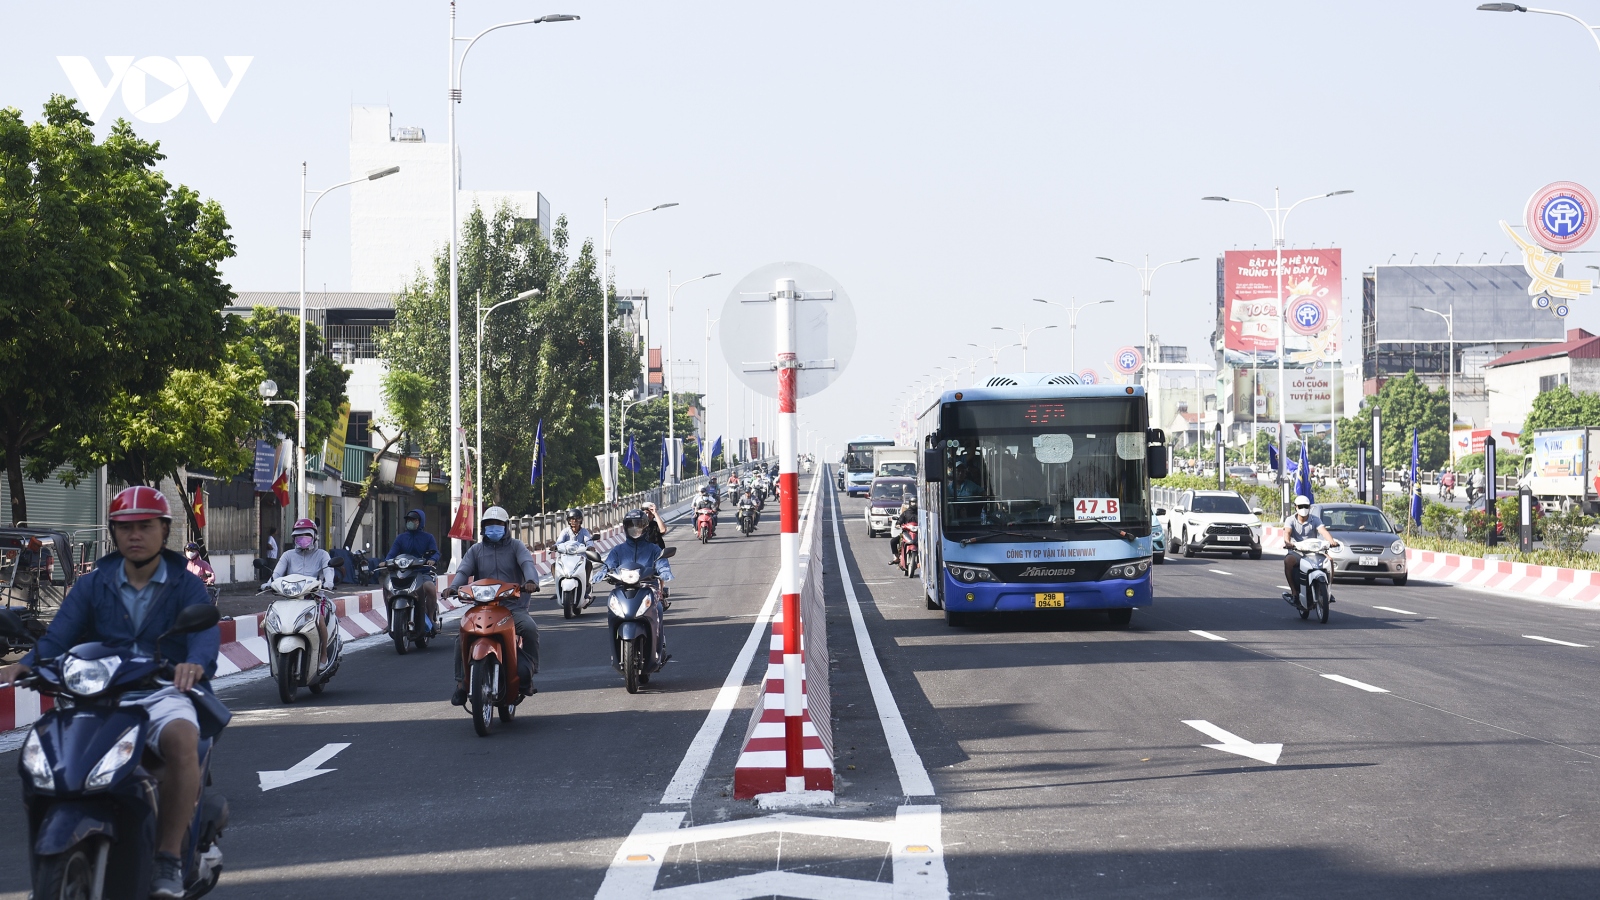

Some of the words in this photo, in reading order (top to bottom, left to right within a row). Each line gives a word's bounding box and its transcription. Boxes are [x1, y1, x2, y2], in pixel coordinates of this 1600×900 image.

[1303, 256, 1320, 265] VUI
[1076, 499, 1118, 514] 47.B
[1006, 549, 1023, 559] CÔNG
[1025, 549, 1032, 558] TY
[1033, 549, 1041, 558] CP
[1068, 548, 1096, 557] NEWWAY
